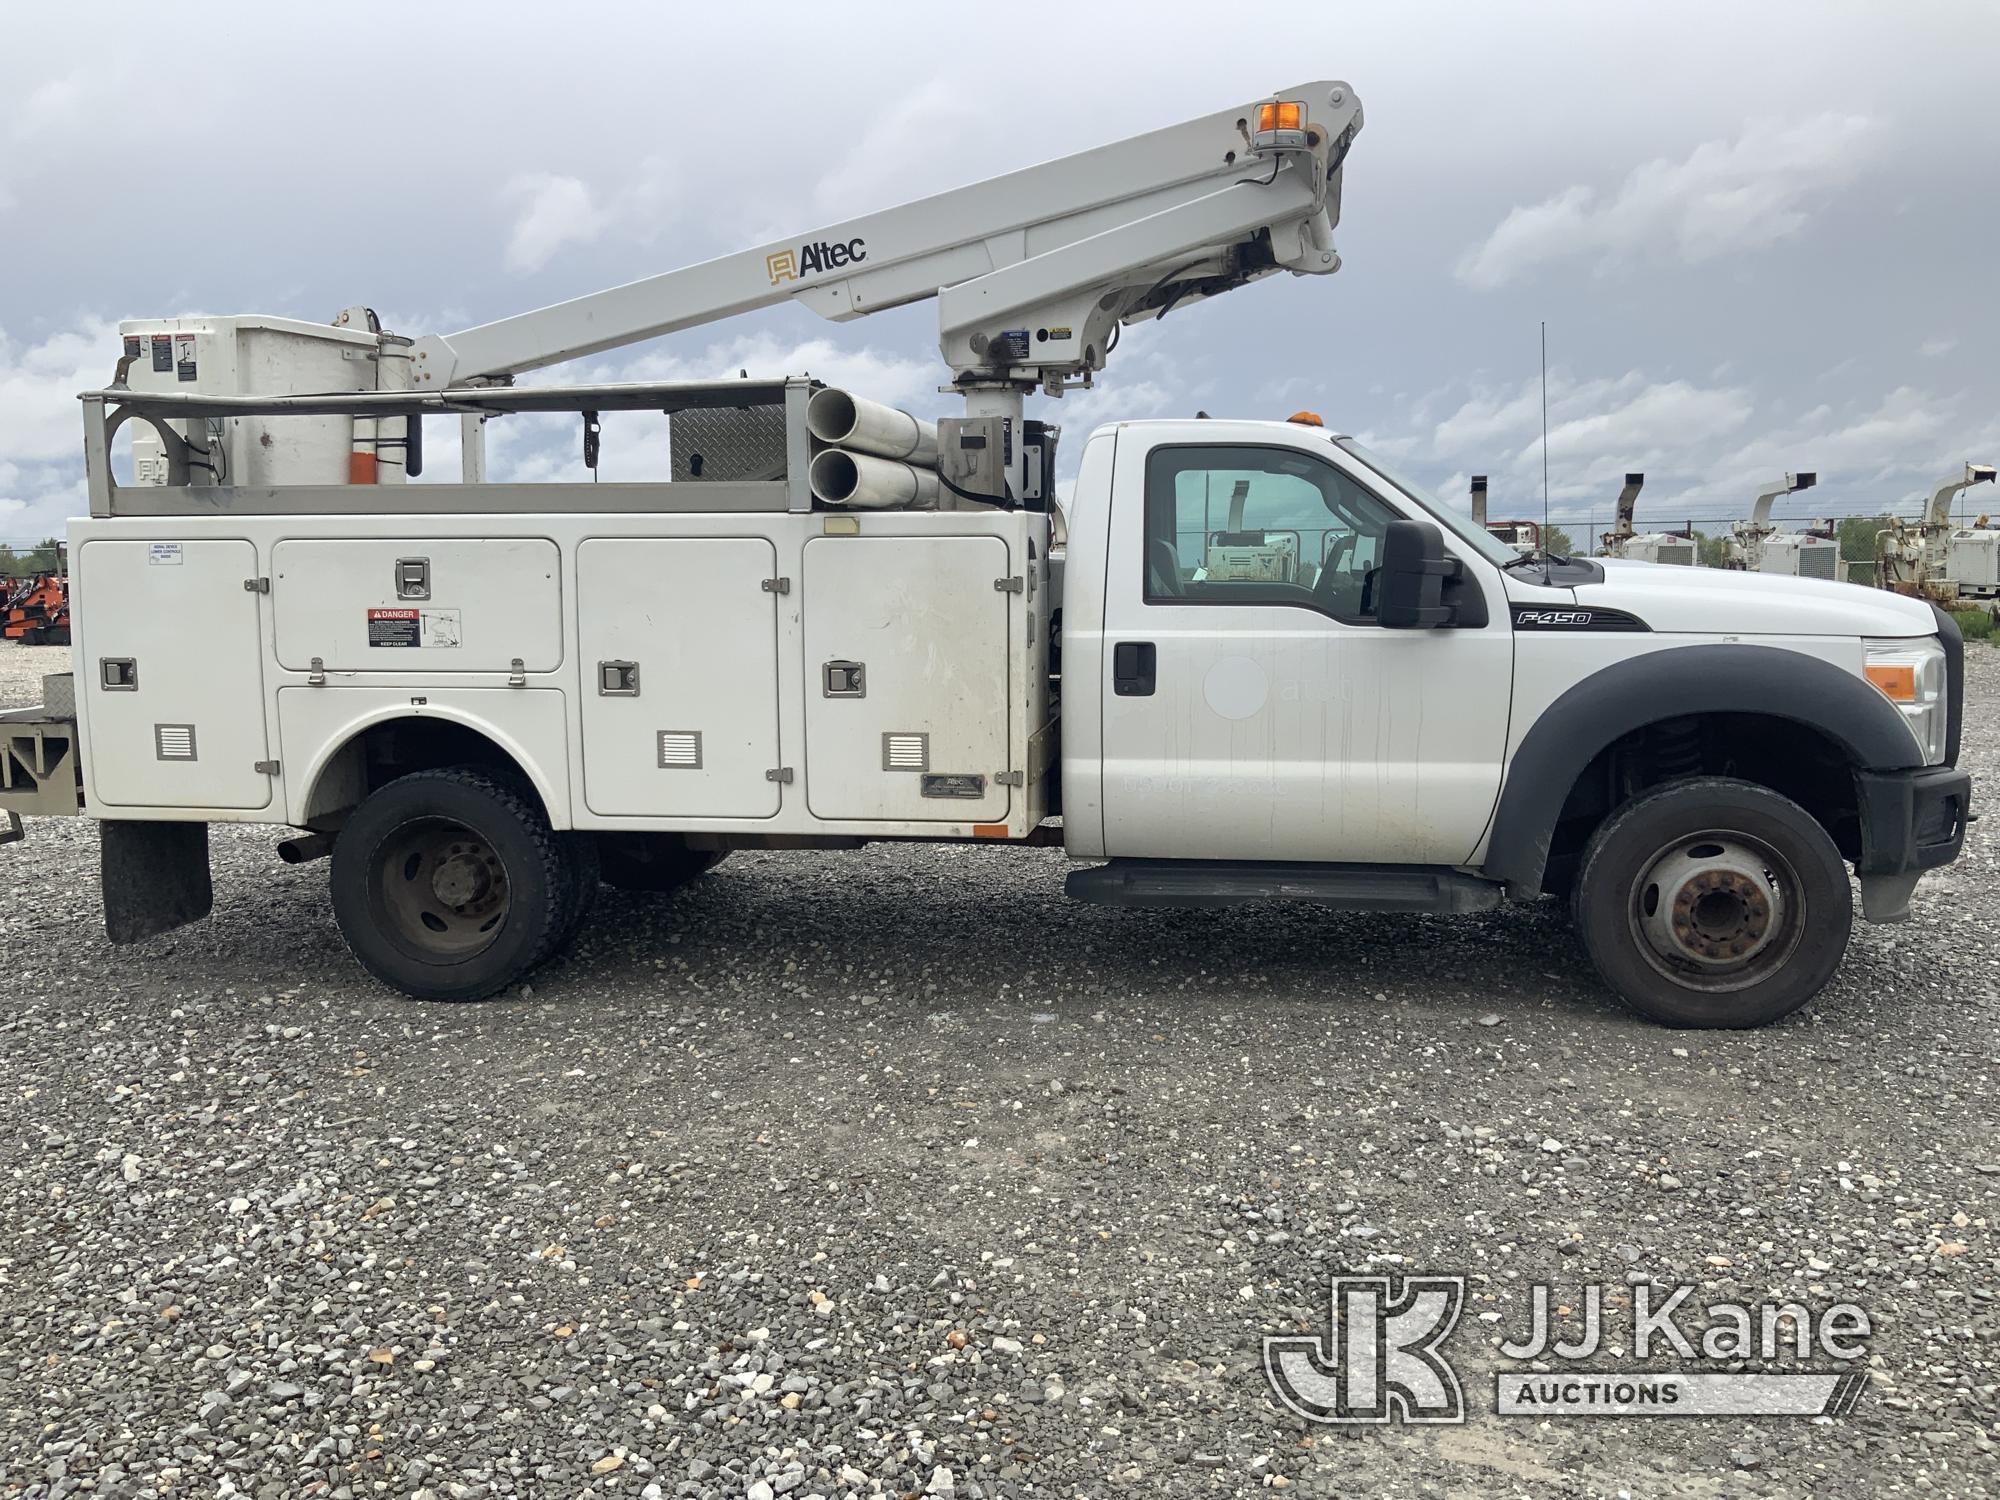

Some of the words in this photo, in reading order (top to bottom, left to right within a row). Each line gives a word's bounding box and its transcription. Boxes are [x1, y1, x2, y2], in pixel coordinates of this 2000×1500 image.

[799, 238, 867, 278] Altec
[381, 610, 415, 619] DANGER
[1516, 611, 1592, 625] F-450
